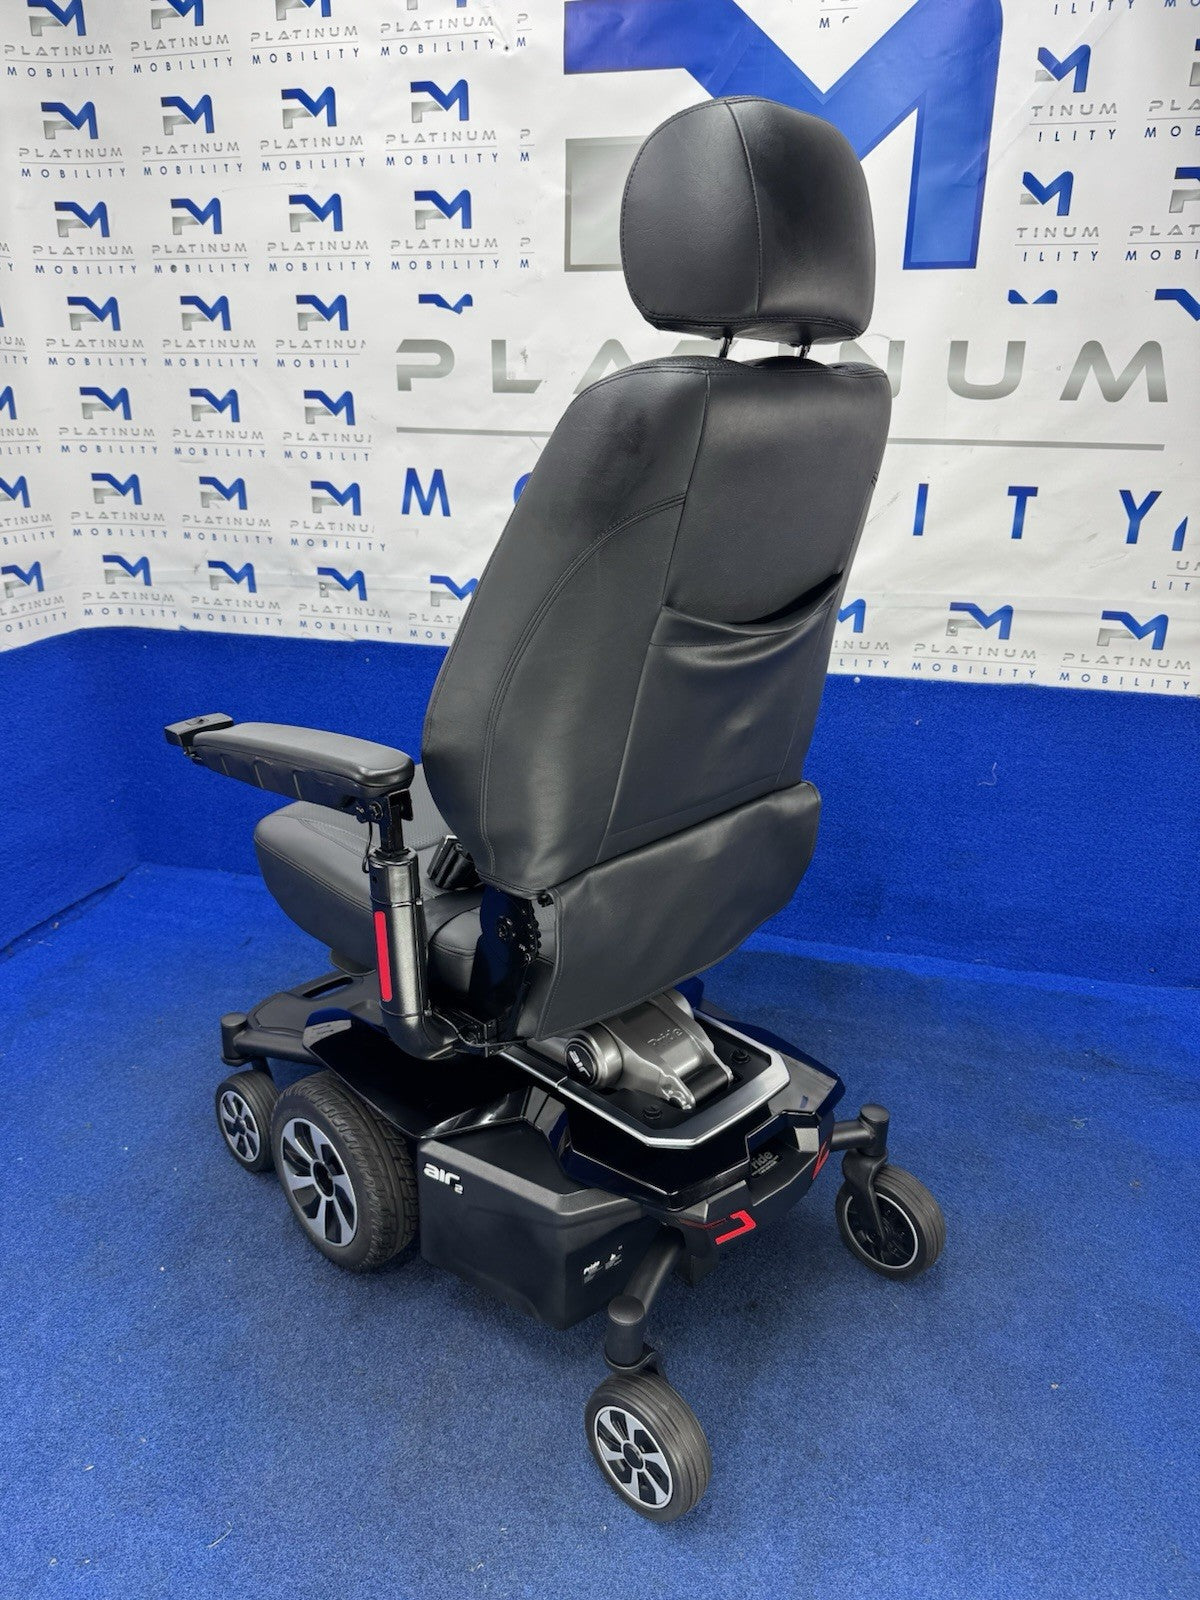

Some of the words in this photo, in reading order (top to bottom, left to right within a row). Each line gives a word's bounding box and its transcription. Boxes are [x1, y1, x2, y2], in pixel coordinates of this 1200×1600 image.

[380, 16, 495, 34] PLATINUM
[251, 25, 358, 42] PLATINUM
[130, 34, 230, 52] PLATINUM
[380, 38, 496, 56] MOBILITY
[5, 44, 112, 56] PLATINUM
[252, 48, 359, 65] MOBILITY
[133, 56, 233, 74] MOBILITY
[7, 66, 115, 78] MOBILITY
[260, 135, 364, 150] PLATINUM
[386, 130, 497, 144] PLATINUM
[19, 147, 123, 158] PLATINUM
[142, 141, 240, 156] PLATINUM
[262, 157, 365, 171] MOBILITY
[386, 152, 498, 167] MOBILITY
[21, 168, 126, 179] MOBILITY
[143, 163, 243, 176] MOBILITY
[152, 243, 247, 255] PLATINUM
[267, 240, 369, 252] PLATINUM
[390, 238, 498, 250] PLATINUM
[32, 245, 134, 256] PLATINUM
[35, 264, 137, 274] MOBILITY
[269, 261, 370, 272] MOBILITY
[391, 258, 499, 270] MOBILITY
[46, 338, 145, 348] PLATINUM
[162, 338, 256, 348] PLATINUM
[48, 357, 148, 366] MOBILITY
[164, 358, 259, 368] MOBILITY
[277, 358, 350, 368] MOBILI
[59, 426, 155, 437] PLATINUM
[172, 429, 264, 440] PLATINUM
[61, 444, 158, 455] MOBILITY
[174, 447, 267, 458] MOBILITY
[71, 511, 165, 522] PLATINUM
[182, 514, 271, 527] PLATINUM
[290, 520, 375, 533] PLATINU
[73, 528, 168, 538] MOBILITY
[184, 531, 273, 545] MOBILITY
[291, 538, 386, 551] MOBILITY
[82, 592, 175, 603] PLATINUM
[191, 596, 281, 610] PLATINUM
[84, 608, 177, 619] MOBILITY
[299, 603, 390, 618] PLATINUM
[193, 613, 283, 626] MOBILITY
[300, 620, 393, 634] MOBILITY
[914, 643, 1036, 660] PLATINUM
[1062, 652, 1191, 670] PLATINUM
[912, 662, 1036, 679] MOBILITY
[1060, 672, 1190, 690] MOBILITY
